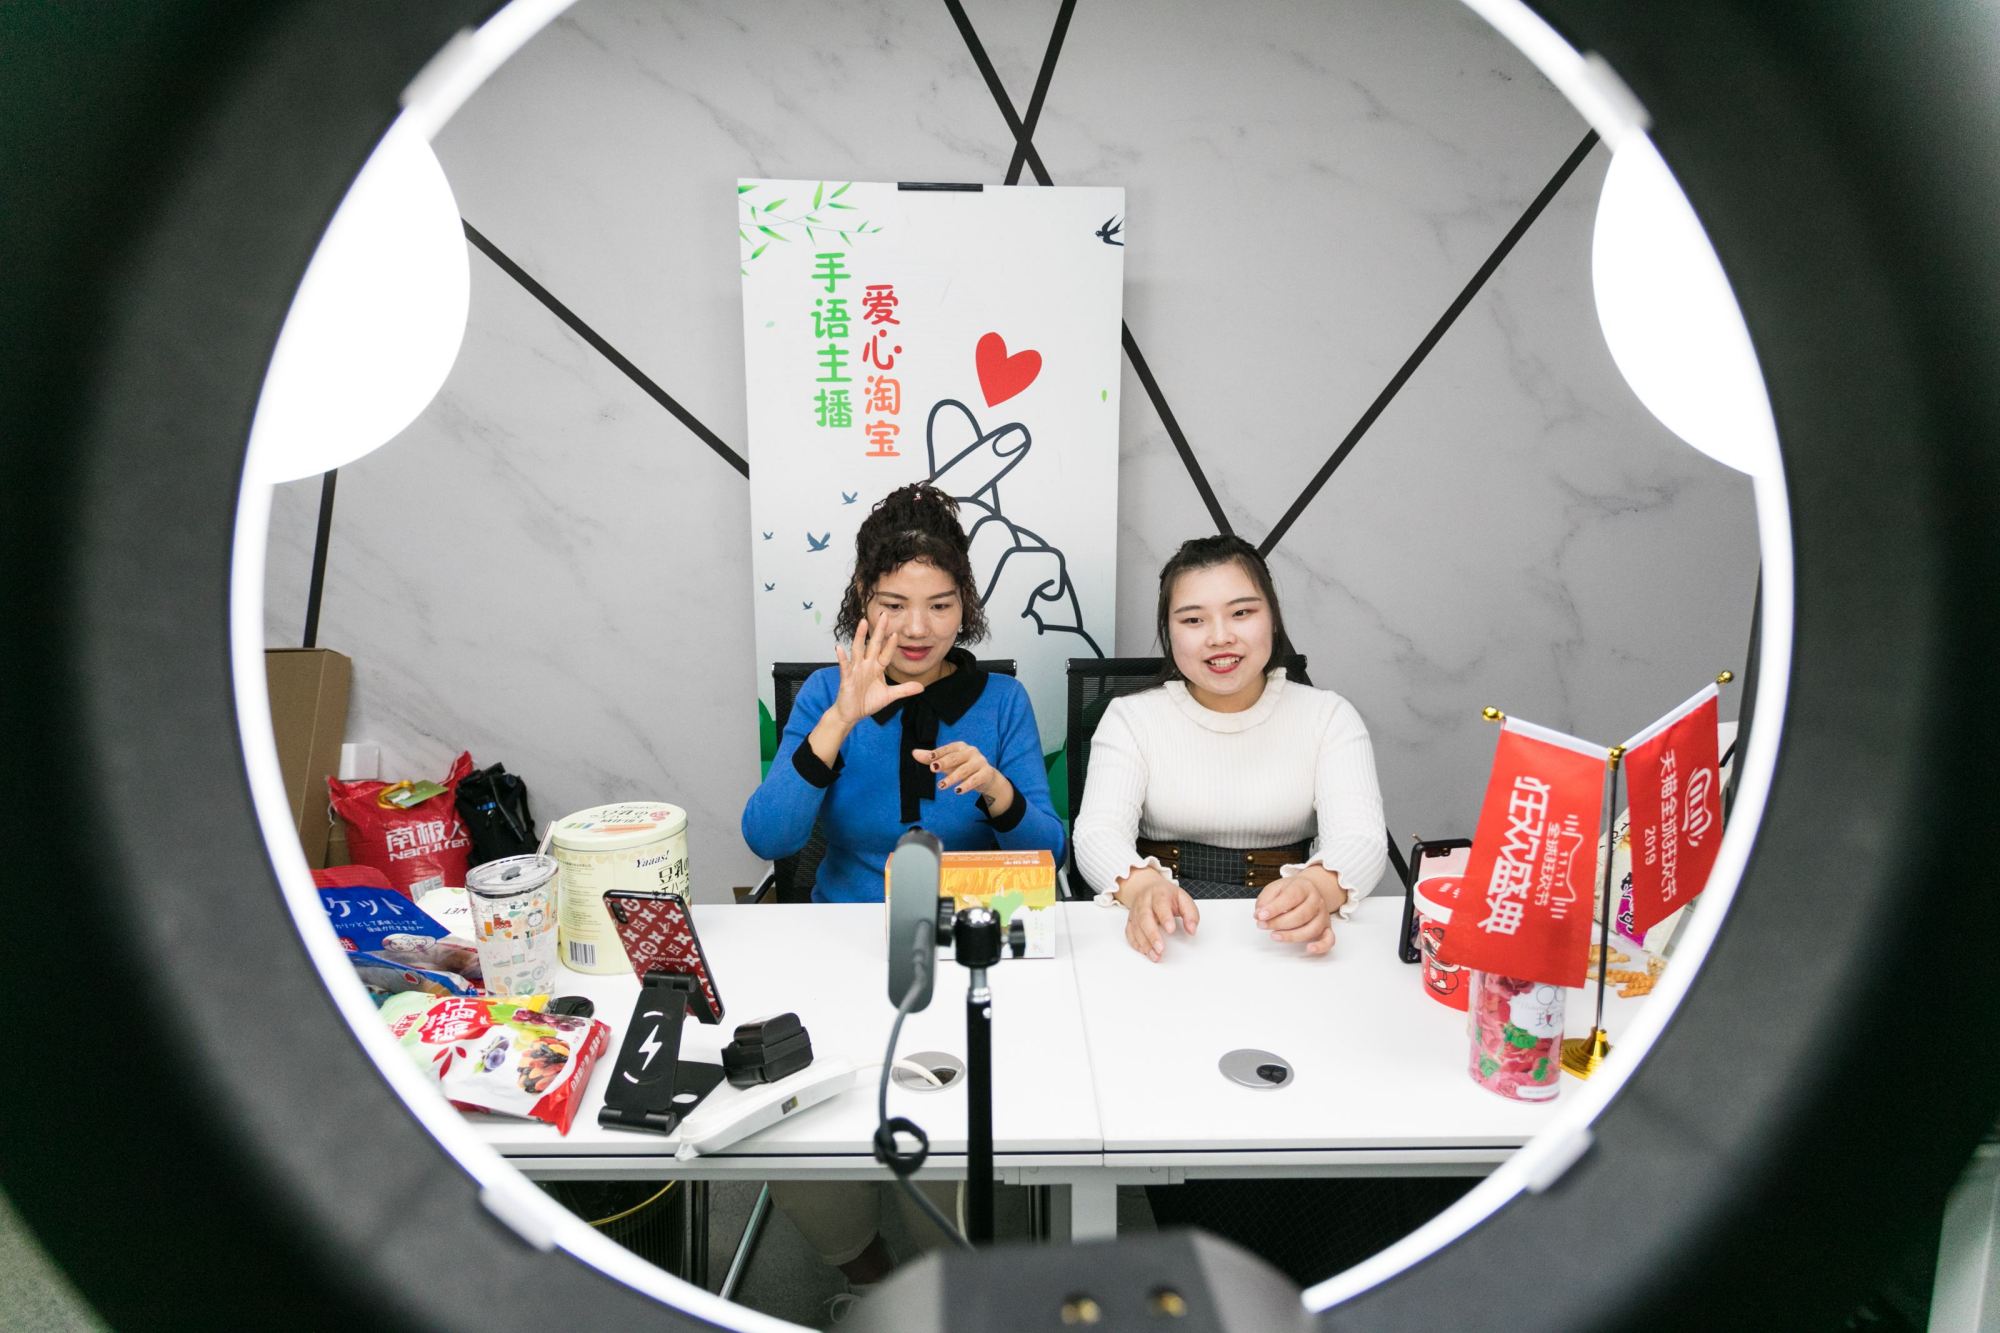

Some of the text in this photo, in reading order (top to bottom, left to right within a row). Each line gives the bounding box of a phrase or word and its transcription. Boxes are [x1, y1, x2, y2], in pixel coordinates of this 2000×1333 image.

[811, 252, 853, 428] 手语主播
[862, 284, 902, 457] 爱心淘宝
[386, 820, 468, 853] 南极人
[1644, 825, 1657, 865] 2019
[1660, 749, 1678, 902] 天猫全球狂欢节
[636, 849, 669, 868] Yaaas!
[1476, 776, 1551, 935] 狂欢盛典
[1534, 822, 1560, 907] 全球狂欢节
[1554, 851, 1569, 887] 11.11
[326, 896, 405, 918] ケット
[650, 954, 682, 963] Supreme
